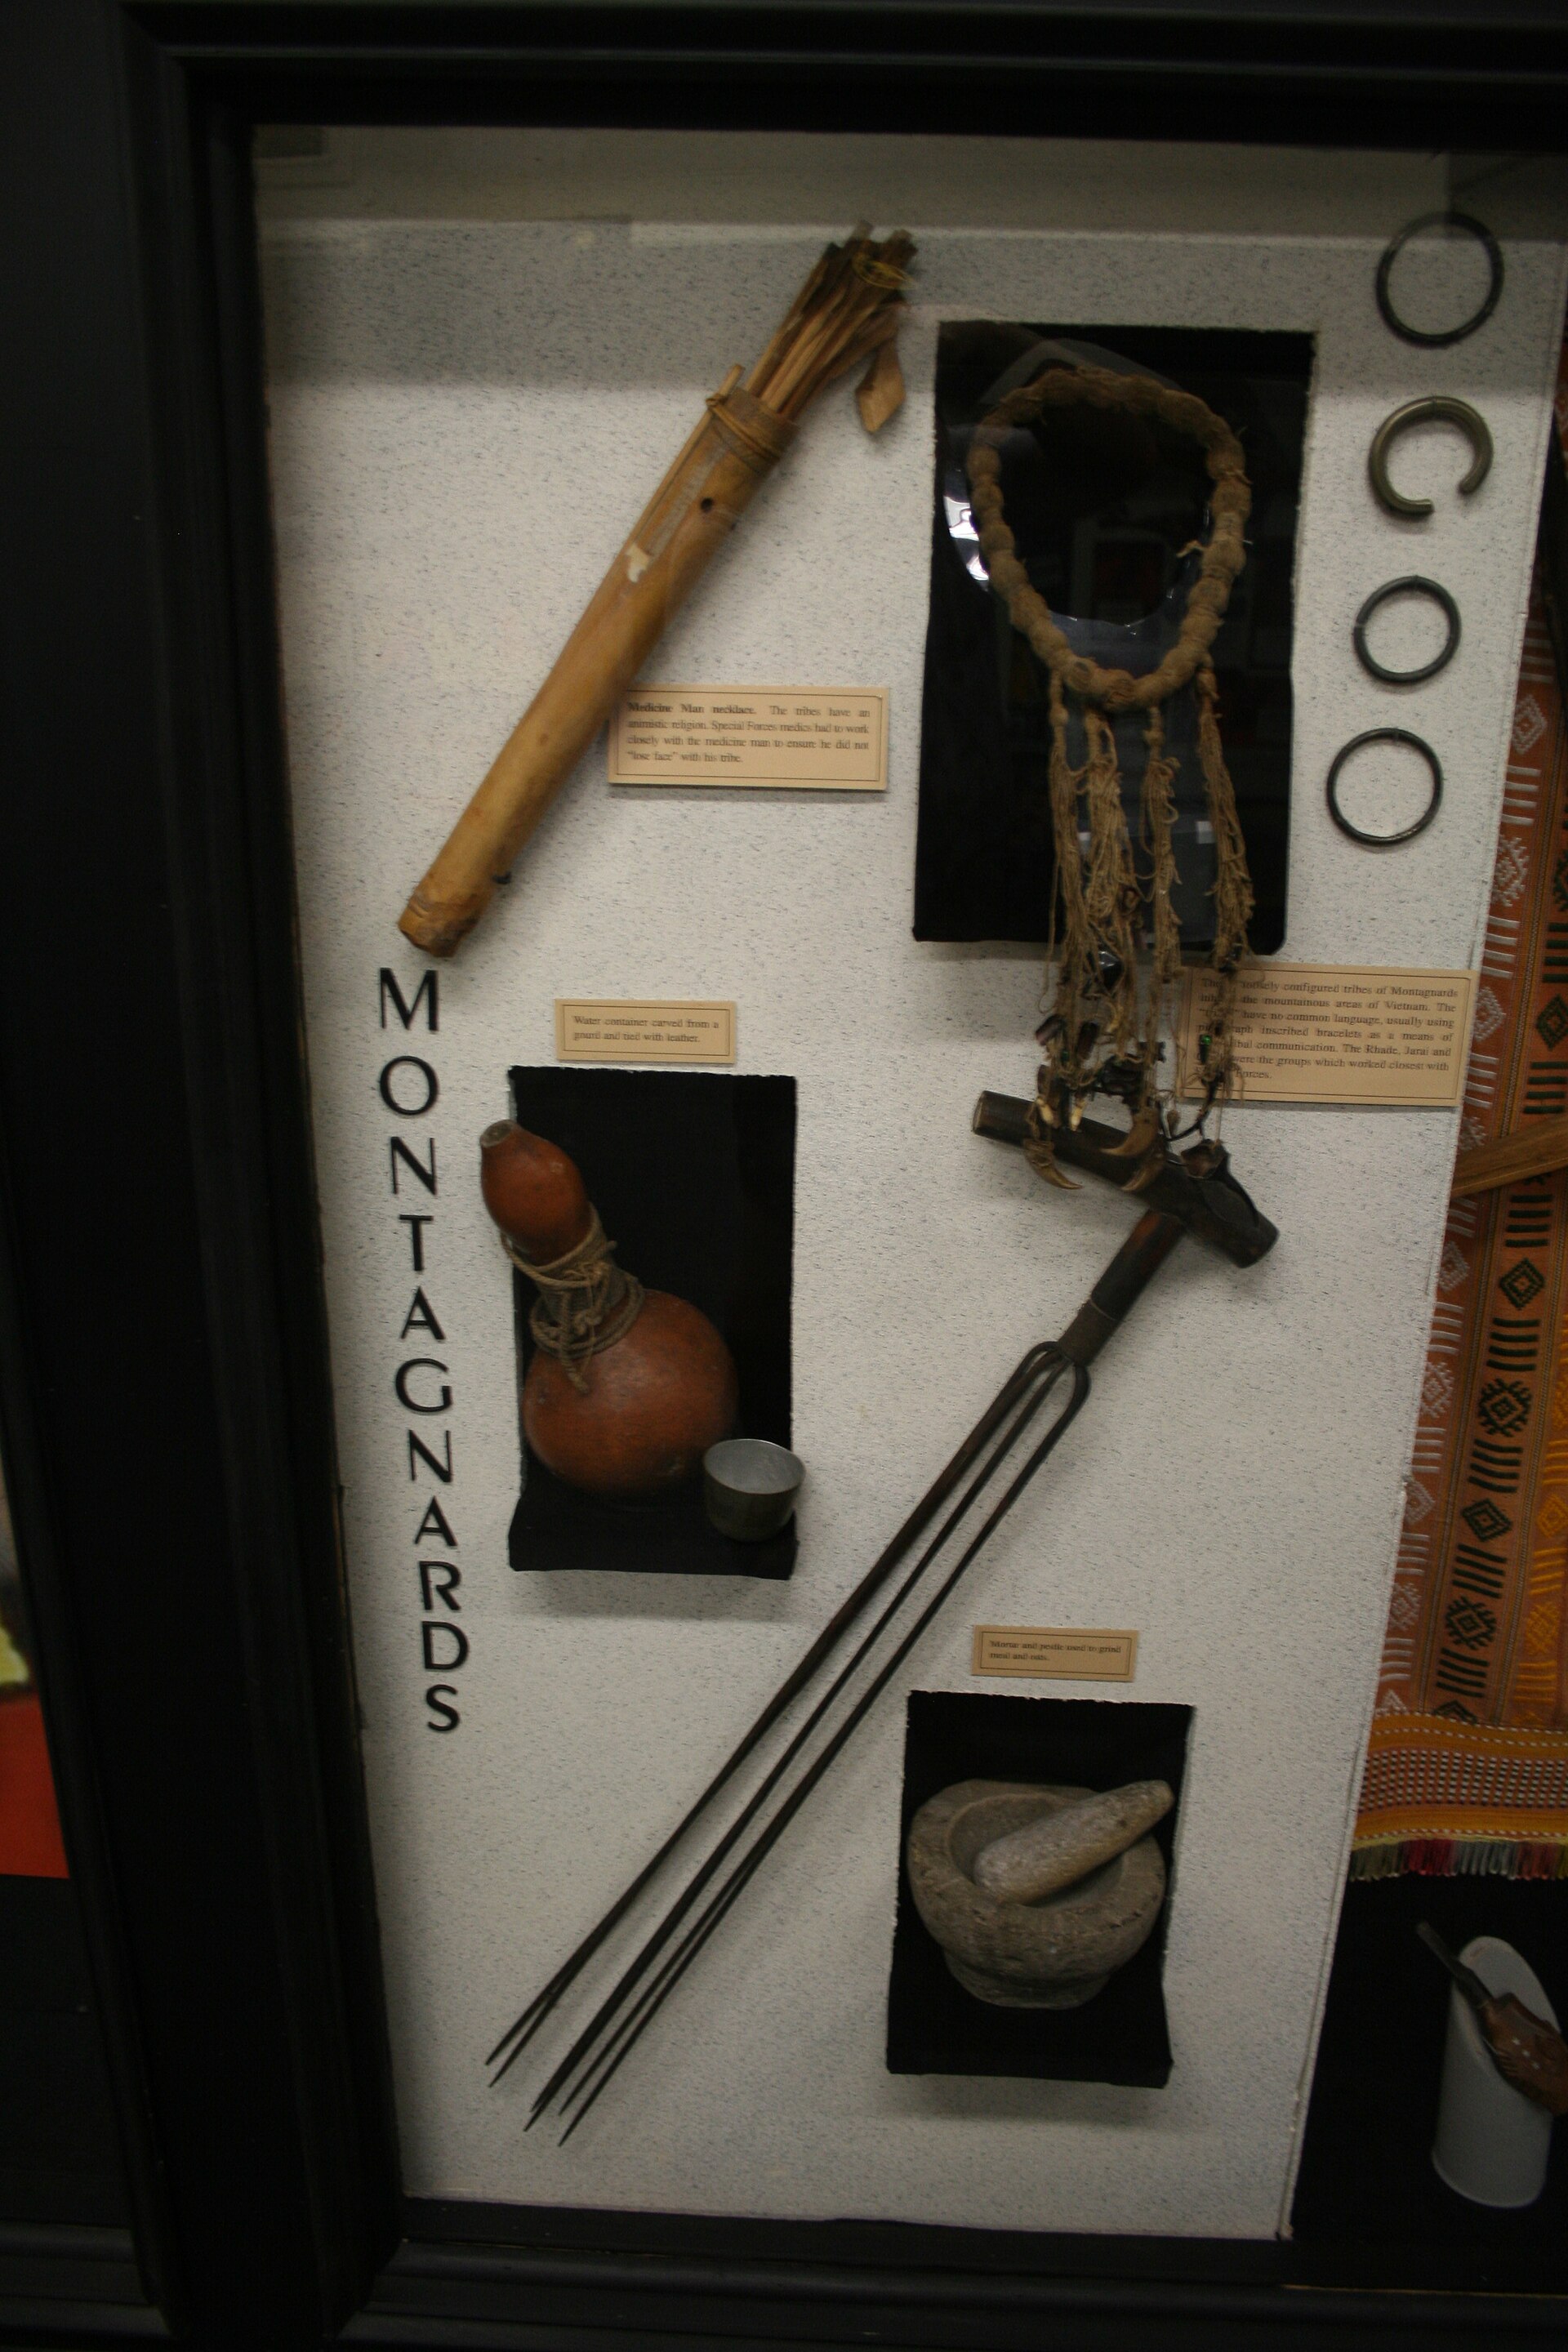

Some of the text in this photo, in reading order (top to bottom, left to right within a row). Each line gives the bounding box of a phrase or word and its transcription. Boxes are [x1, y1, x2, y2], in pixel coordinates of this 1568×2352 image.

[627, 702, 673, 712] Medicine
[680, 703, 704, 713] Man
[712, 705, 757, 714] necklace.
[769, 706, 787, 715] The
[794, 706, 821, 715] tribes
[828, 707, 851, 716] have
[627, 719, 869, 733] animistic religion. Special Forces medics had to work
[627, 735, 659, 746] closely
[664, 736, 684, 745] with
[706, 738, 746, 746] medicine
[821, 739, 831, 748] he
[835, 739, 851, 749] did
[680, 752, 702, 761] with
[704, 752, 716, 761] his
[719, 754, 743, 762] tribe.
[1284, 983, 1339, 992] configured
[1343, 985, 1373, 994] tribes
[1391, 987, 1458, 998] Montagnards
[1241, 996, 1258, 1004] the
[1264, 998, 1330, 1007] mountainous
[1369, 1000, 1379, 1009] of
[1384, 1001, 1430, 1011] Vietnam.
[1437, 1003, 1457, 1012] The
[572, 1016, 601, 1025] Water
[605, 1018, 648, 1027] container
[652, 1018, 683, 1027] carved
[686, 1019, 710, 1028] from
[1243, 1011, 1267, 1019] have
[1286, 1013, 1330, 1022] common
[1334, 1013, 1383, 1025] language,
[1387, 1017, 1423, 1027] usually
[1427, 1018, 1454, 1028] using
[573, 1031, 600, 1040] gourd
[604, 1031, 620, 1040] and
[623, 1032, 640, 1040] tied
[644, 1033, 663, 1041] with
[1262, 1027, 1309, 1036] inscribed
[1316, 1030, 1362, 1038] bracelets
[1442, 1032, 1454, 1041] of
[1257, 1042, 1339, 1052] communication.
[1343, 1044, 1361, 1053] The
[1365, 1045, 1401, 1054] Rhade,
[1405, 1046, 1429, 1055] Jarai
[1258, 1056, 1274, 1064] the
[1277, 1058, 1312, 1067] groups
[1349, 1060, 1386, 1068] worked
[1389, 1062, 1423, 1070] closest
[1427, 1062, 1449, 1071] with
[379, 967, 469, 1733] MONTAGNARDS
